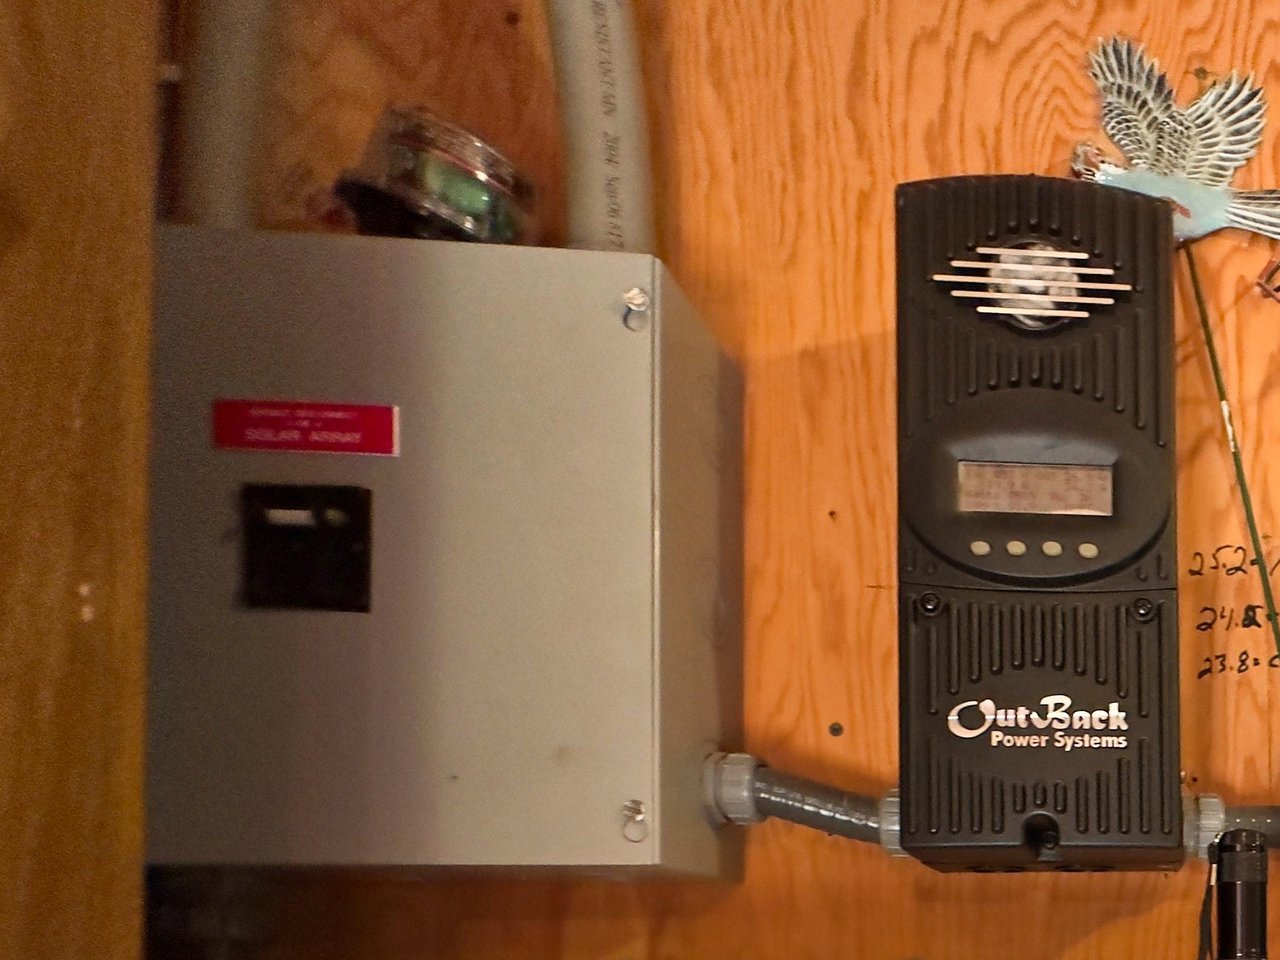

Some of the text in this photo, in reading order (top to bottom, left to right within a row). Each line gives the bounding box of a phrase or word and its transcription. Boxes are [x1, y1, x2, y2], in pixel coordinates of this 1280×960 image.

[948, 695, 1129, 738] OutBack
[990, 731, 1128, 751] Power Systems
